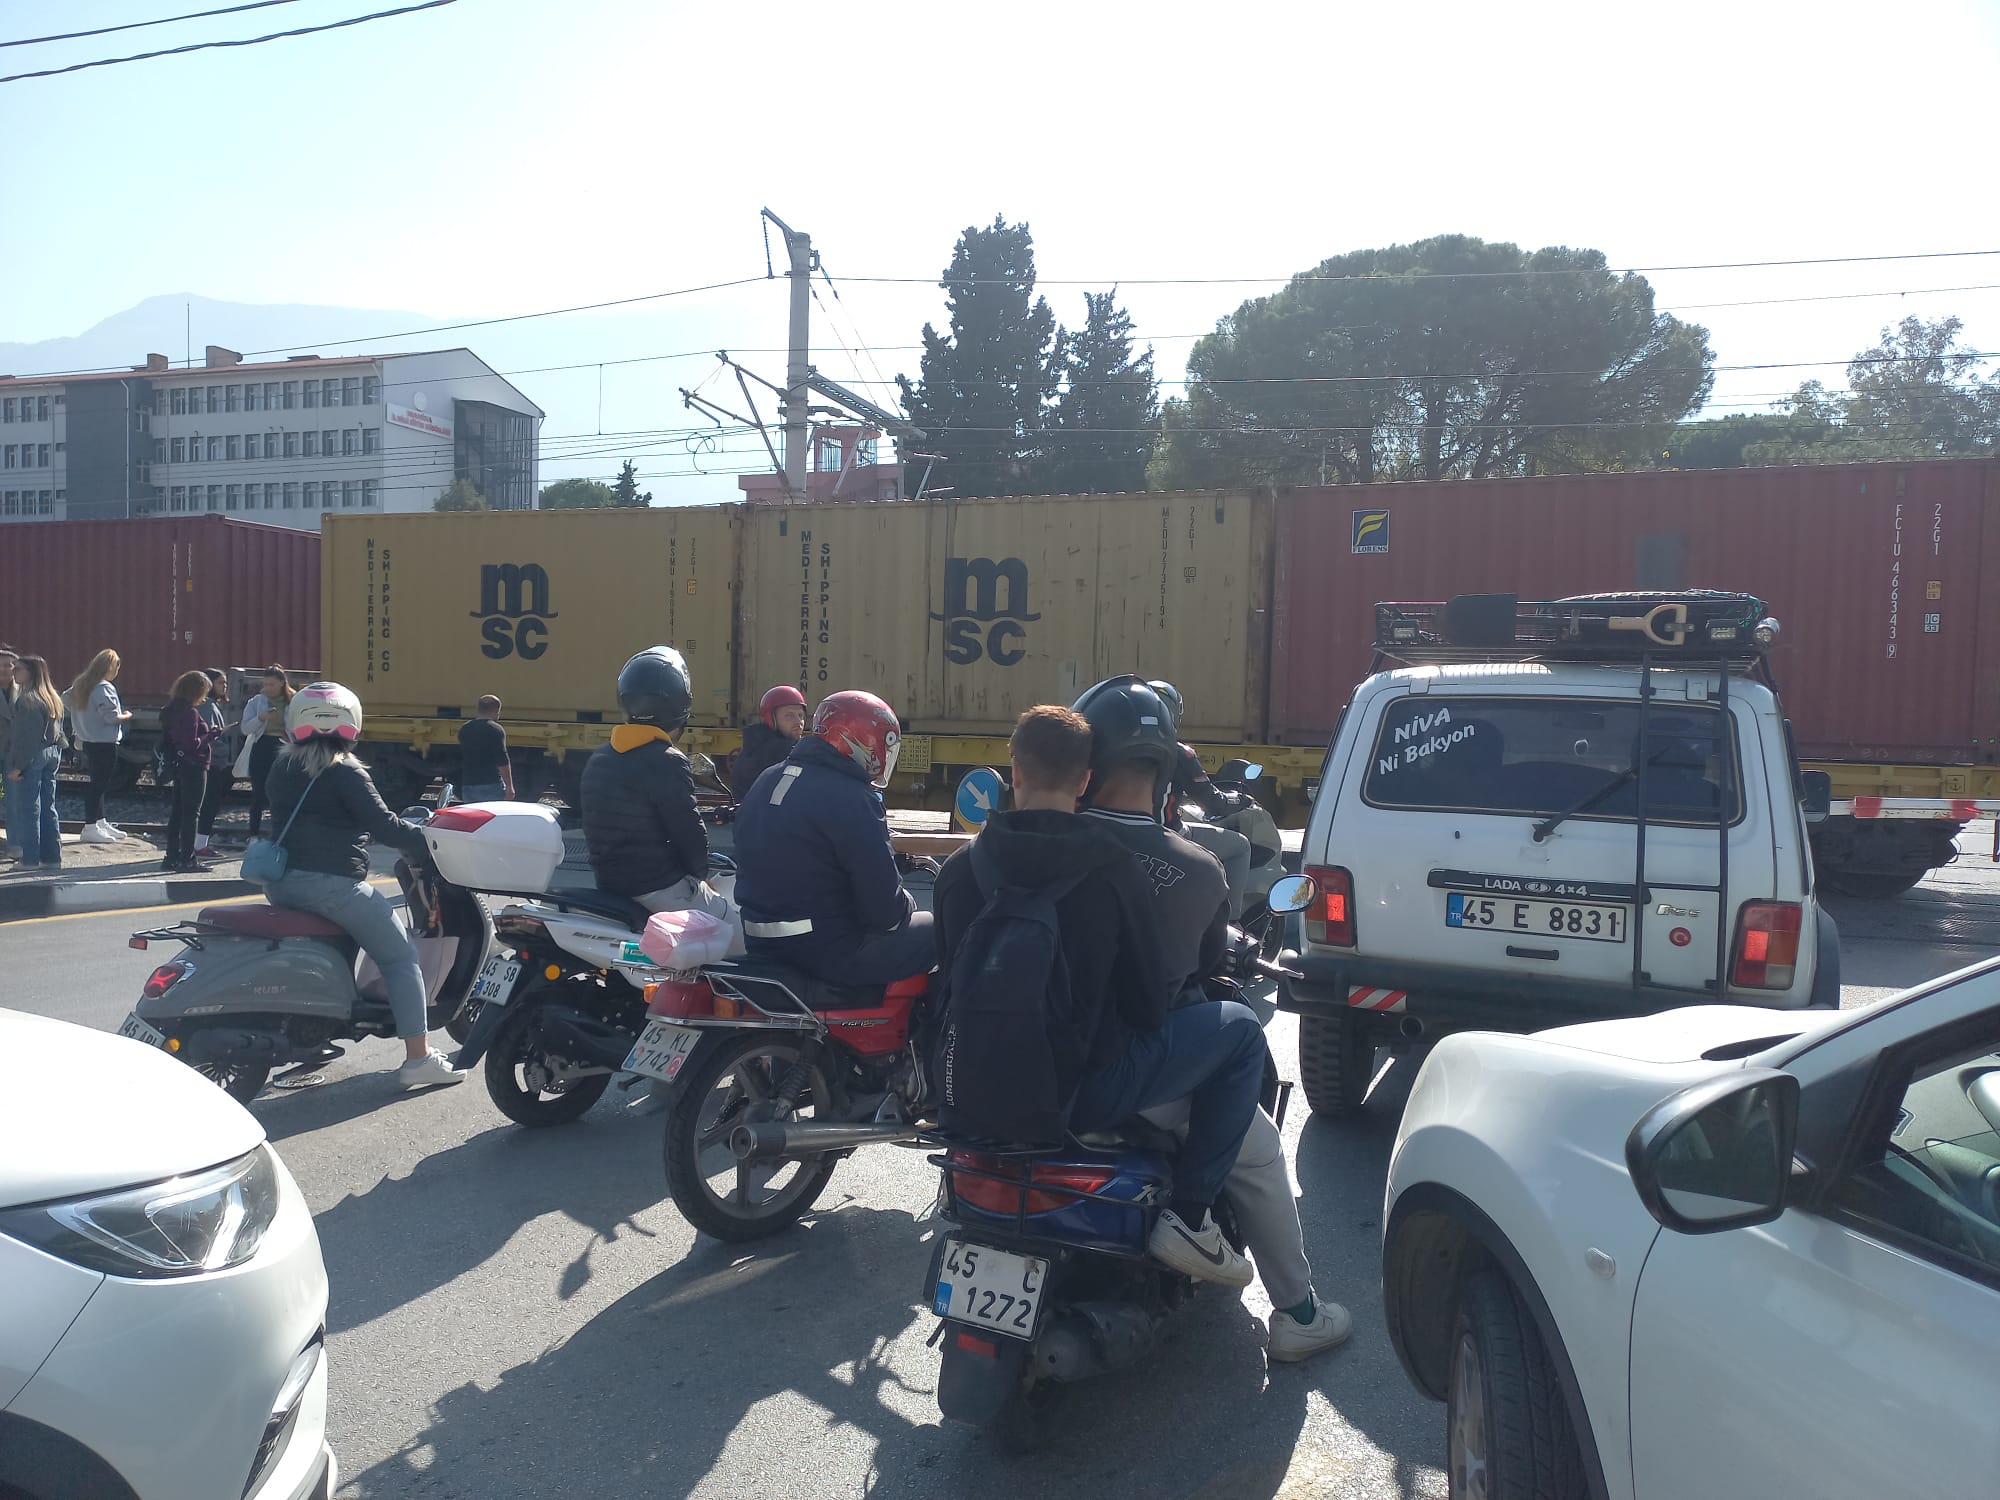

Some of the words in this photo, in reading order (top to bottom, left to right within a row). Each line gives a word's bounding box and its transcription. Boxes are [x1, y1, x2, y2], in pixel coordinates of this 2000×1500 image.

[1893, 504, 1903, 557] FCIU
[1933, 503, 1942, 556] 22G1
[367, 538, 375, 683] MEDITERRANEAN
[382, 549, 390, 638] SHIPPING
[800, 531, 811, 693] MEDITERRANEAN
[819, 543, 830, 643] SHIPPING
[1889, 561, 1900, 639] 466343
[382, 650, 390, 672] CO
[818, 657, 828, 681] CO
[1888, 644, 1896, 658] 9
[1380, 754, 1399, 775] Ni
[1404, 725, 1475, 763] Bakyon
[1484, 879, 1522, 891] LADA
[1450, 912, 1462, 920] TR
[1463, 900, 1495, 925] 45
[1513, 904, 1530, 928] E
[1549, 907, 1616, 937] 8831
[483, 981, 500, 998] 308
[485, 962, 498, 976] 45
[504, 967, 517, 982] SB
[125, 1021, 139, 1038] 45
[643, 1027, 666, 1044] 45
[670, 1032, 690, 1053] KL
[638, 1050, 671, 1071] 742
[946, 1248, 978, 1279] 45
[1022, 1266, 1039, 1293] C
[937, 1302, 947, 1312] TR
[966, 1287, 1031, 1328] 1272
